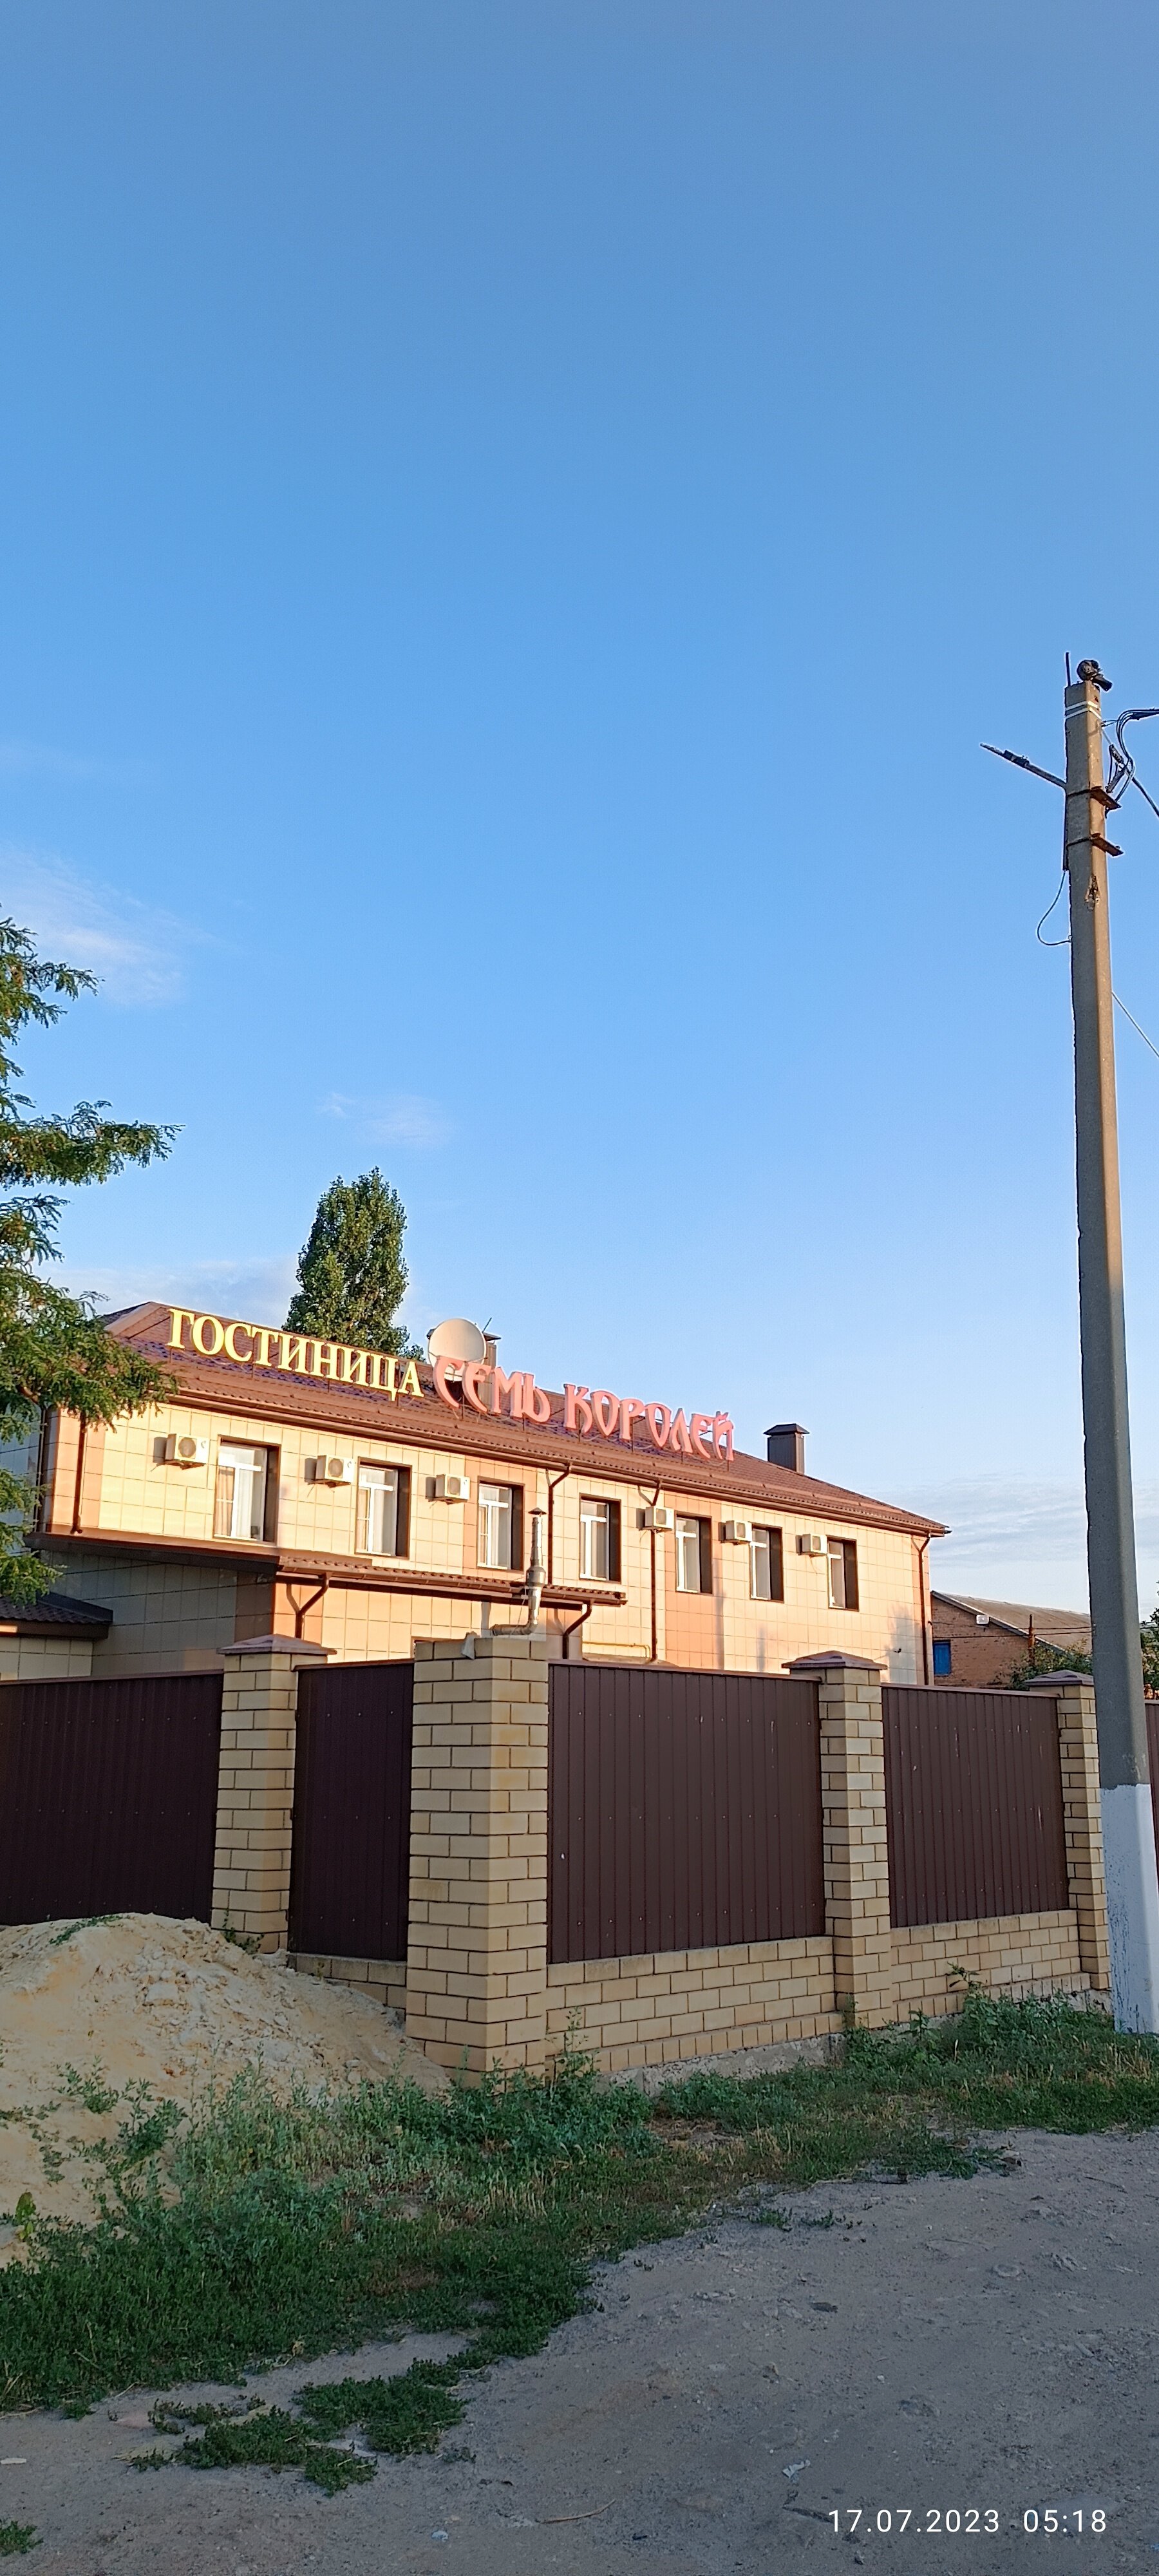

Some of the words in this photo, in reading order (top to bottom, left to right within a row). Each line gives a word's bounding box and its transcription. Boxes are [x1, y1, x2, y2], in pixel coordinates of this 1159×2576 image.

[167, 1308, 425, 1401] ГОСТИНИЦА
[433, 1355, 551, 1423] СЕМЬ
[563, 1383, 735, 1461] КОРОЛЕЙ
